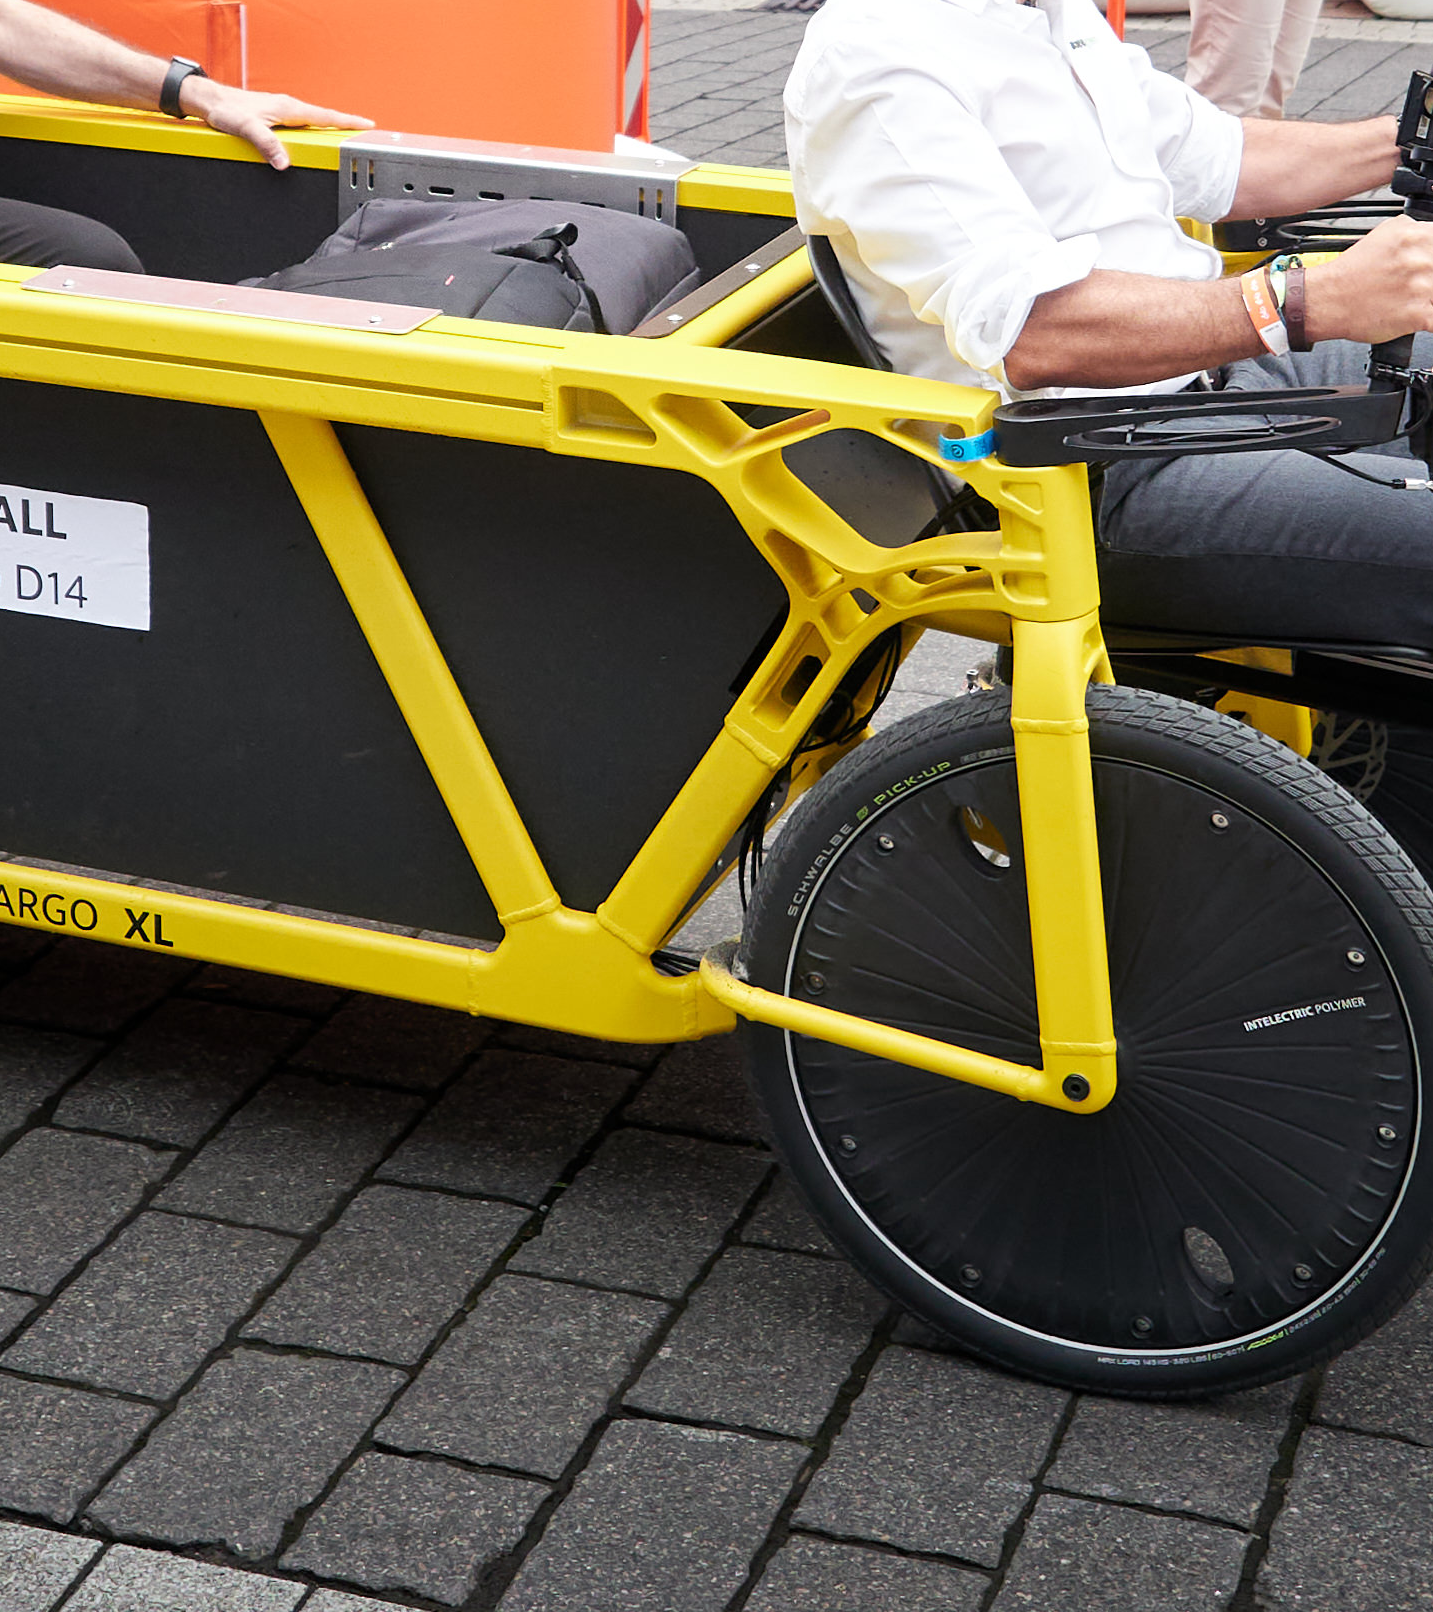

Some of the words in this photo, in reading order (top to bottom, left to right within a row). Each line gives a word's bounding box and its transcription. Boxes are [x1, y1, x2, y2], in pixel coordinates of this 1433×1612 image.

[16, 564, 88, 608] D14
[787, 823, 854, 917] SCHWALBE
[873, 761, 951, 805] PICK-UP
[124, 907, 175, 947] XL
[1243, 1006, 1315, 1032] INTELECTRIC
[1314, 996, 1367, 1015] POLYMER
